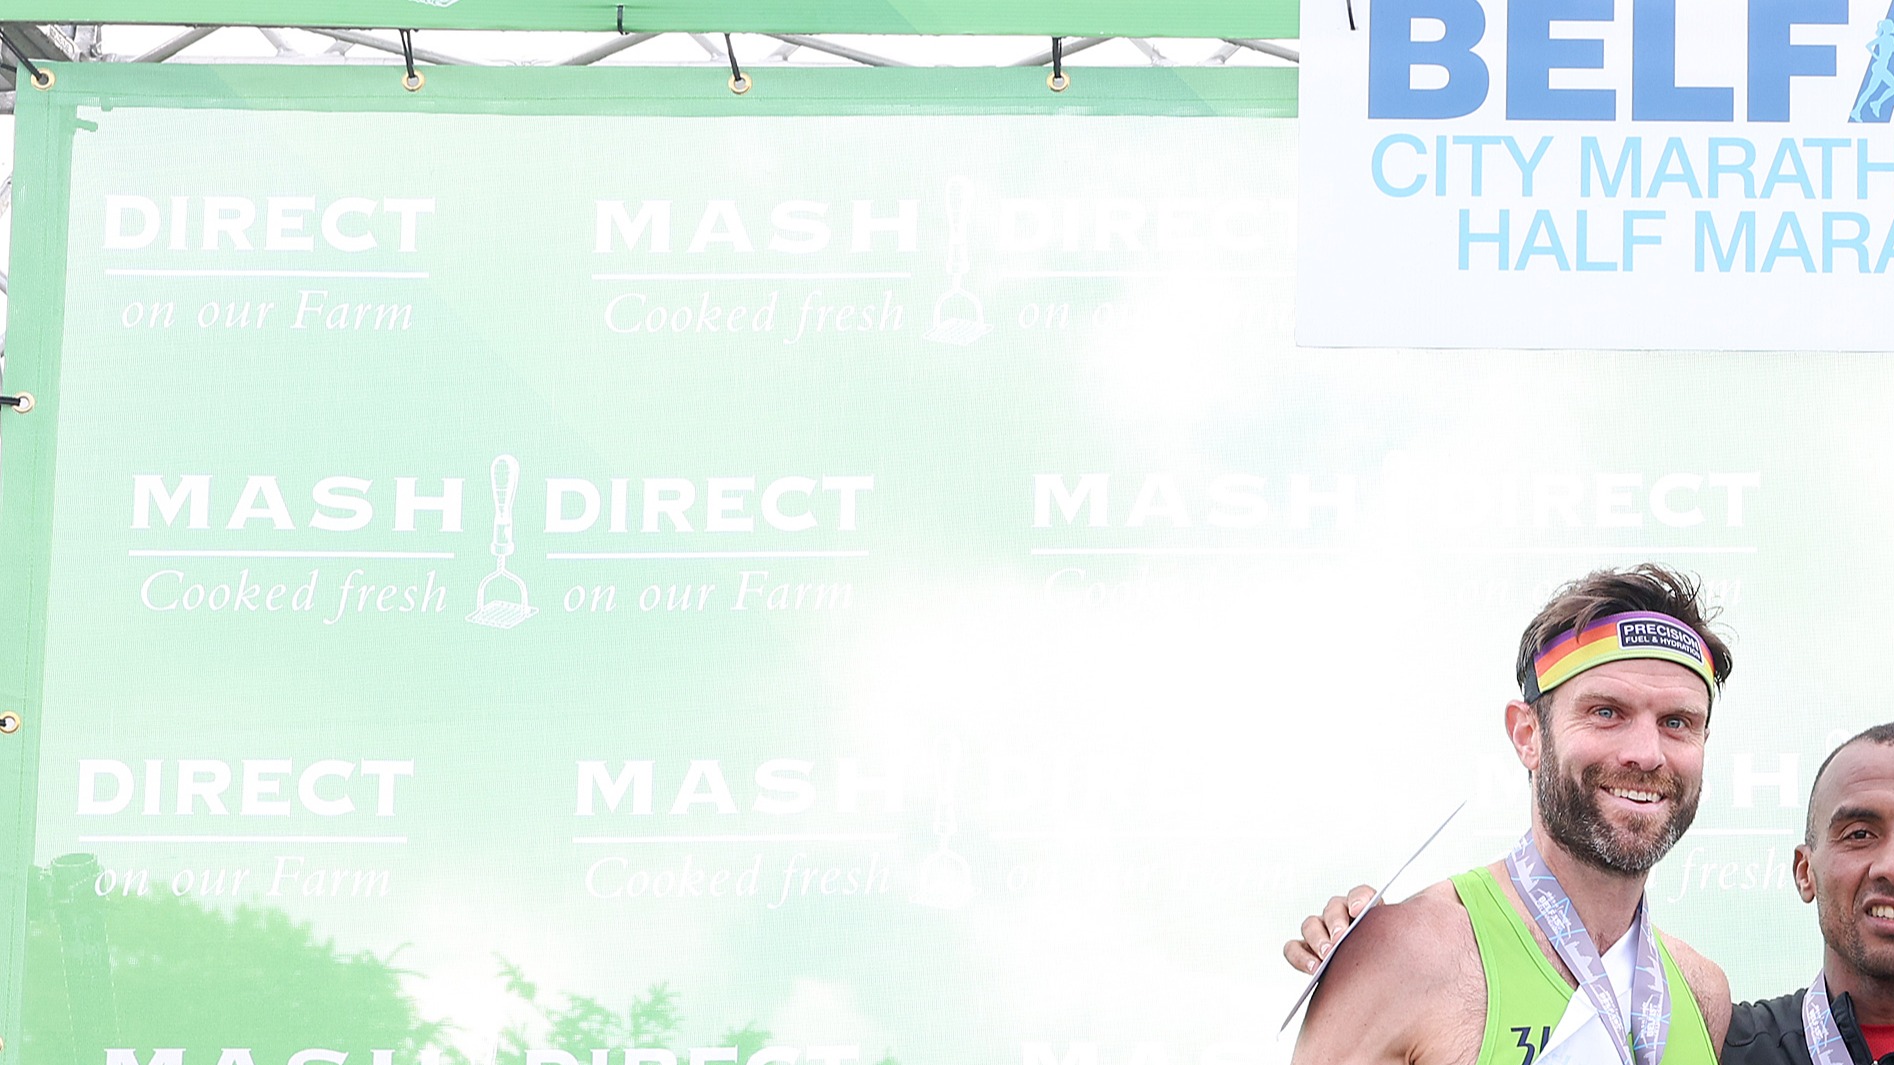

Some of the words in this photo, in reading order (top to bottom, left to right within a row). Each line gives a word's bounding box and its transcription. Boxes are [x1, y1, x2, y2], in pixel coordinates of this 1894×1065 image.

[1371, 133, 1553, 198] CITY
[104, 193, 436, 252] DIRECT
[1458, 209, 1666, 272] HALF
[131, 474, 463, 532] MASH
[547, 475, 875, 533] DIRECT
[140, 568, 319, 611] Cooked
[323, 569, 446, 625] fresh
[564, 585, 616, 612] on
[639, 583, 716, 611] our
[733, 569, 855, 611] Farm
[1624, 623, 1700, 651] PRECISION
[1660, 638, 1701, 659] HYDRATION
[77, 759, 414, 817] DIRECT
